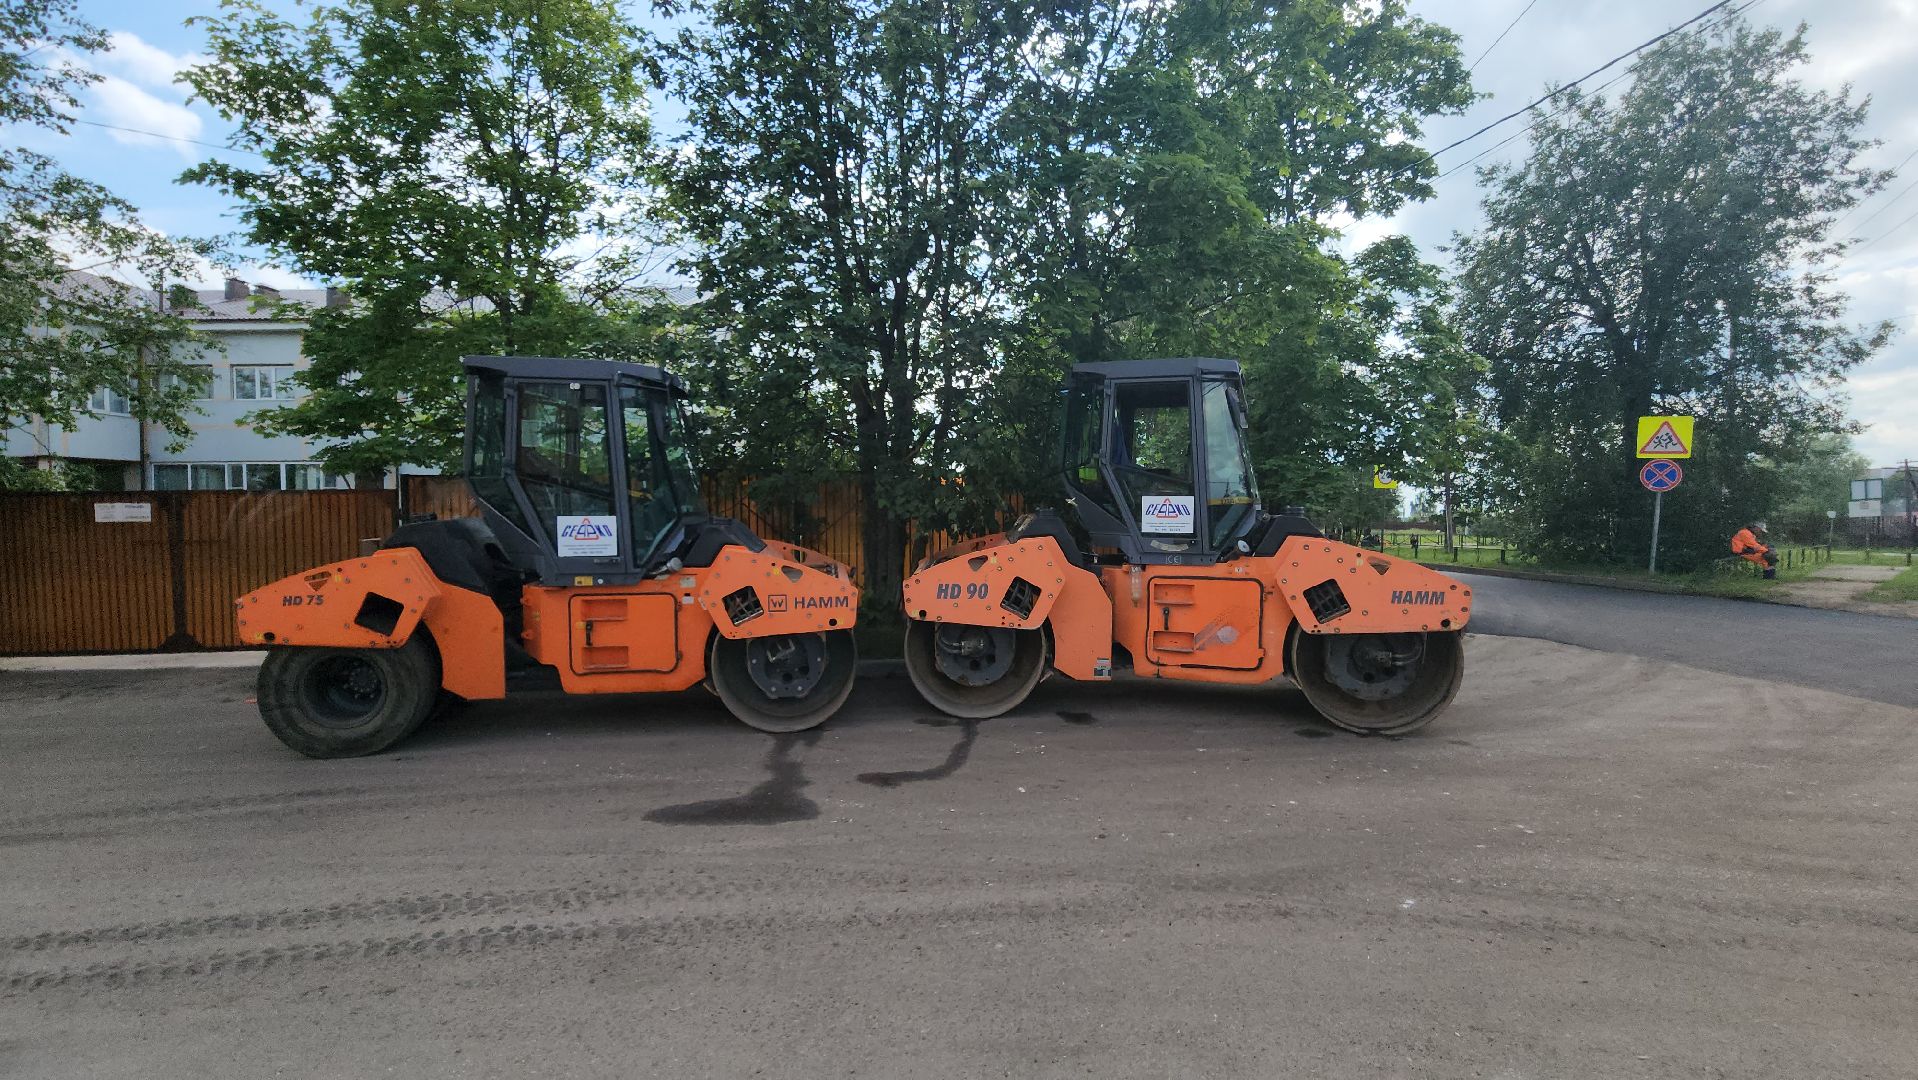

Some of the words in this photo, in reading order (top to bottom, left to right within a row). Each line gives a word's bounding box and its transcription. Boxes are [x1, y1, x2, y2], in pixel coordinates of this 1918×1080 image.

[937, 583, 961, 600] HD
[966, 582, 989, 600] 90
[1391, 590, 1445, 605] HAMM
[282, 595, 303, 607] HD
[306, 594, 324, 606] 75
[794, 595, 849, 610] HAMM
